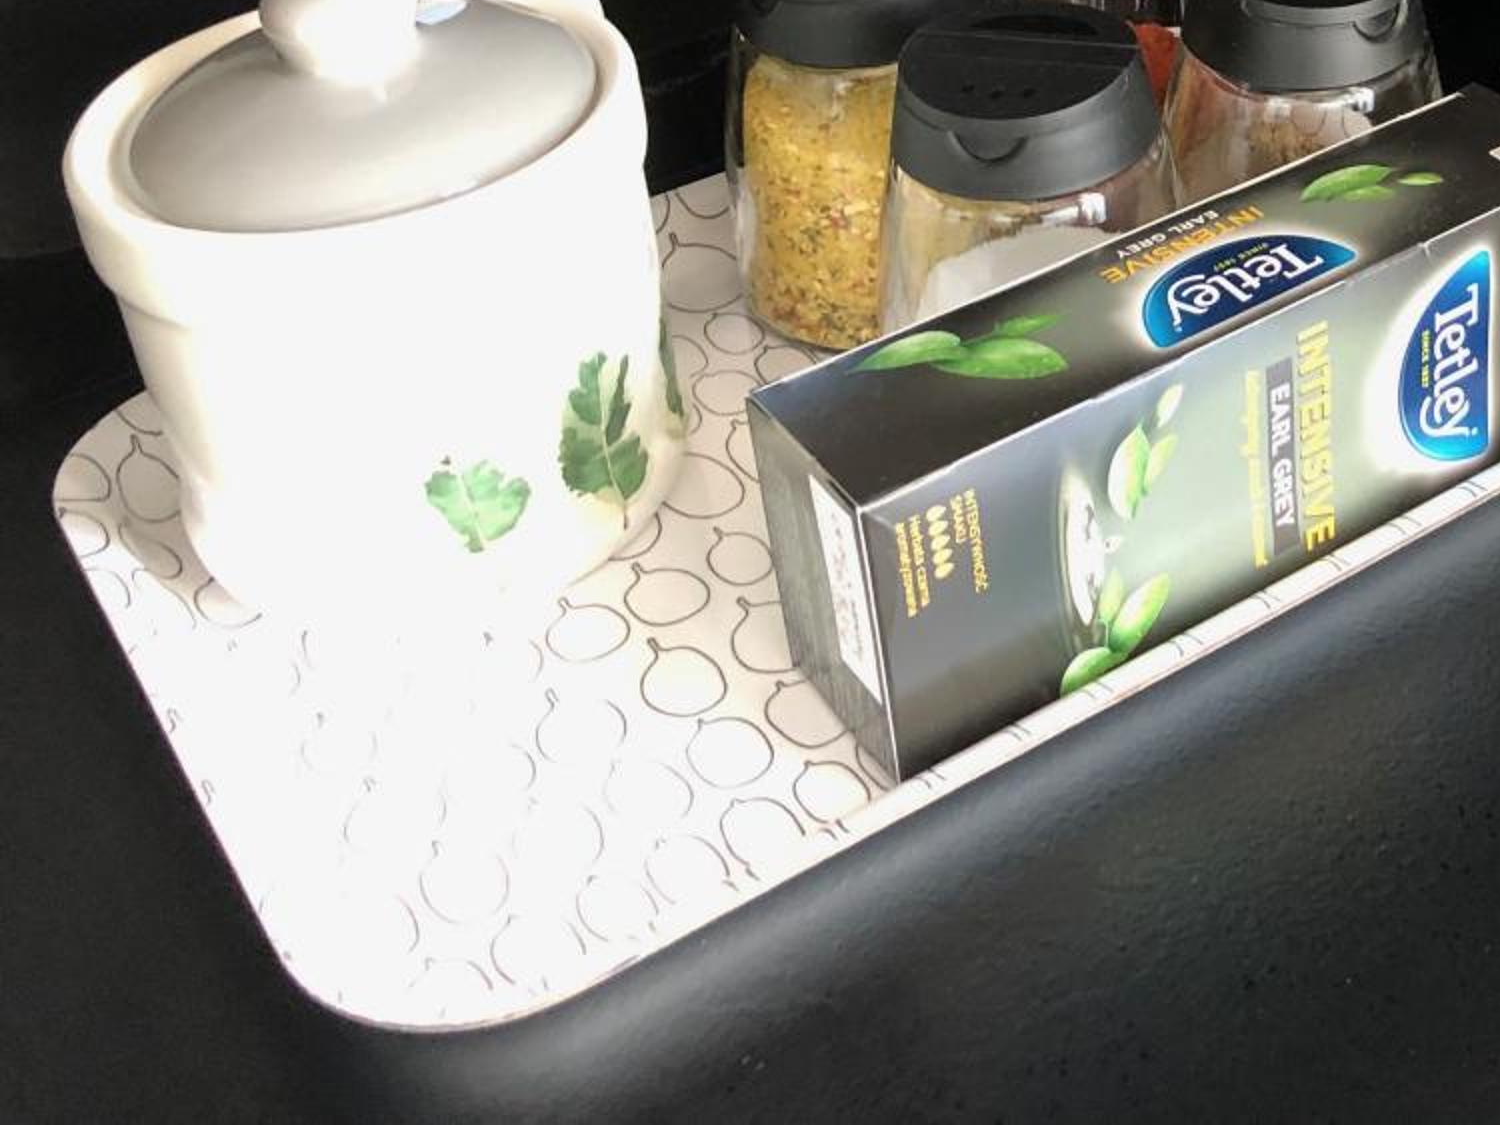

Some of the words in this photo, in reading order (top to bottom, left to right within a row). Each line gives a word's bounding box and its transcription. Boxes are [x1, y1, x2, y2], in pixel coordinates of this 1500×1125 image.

[1101, 204, 1264, 285] INTENSIVE
[1116, 234, 1167, 260] GREY
[1168, 210, 1219, 235] EARL
[1167, 243, 1324, 332] Tetley
[1420, 282, 1479, 437] Tetley
[1271, 383, 1292, 458] EARL
[1297, 320, 1336, 552] INTENSIVE
[1273, 458, 1295, 527] GREY
